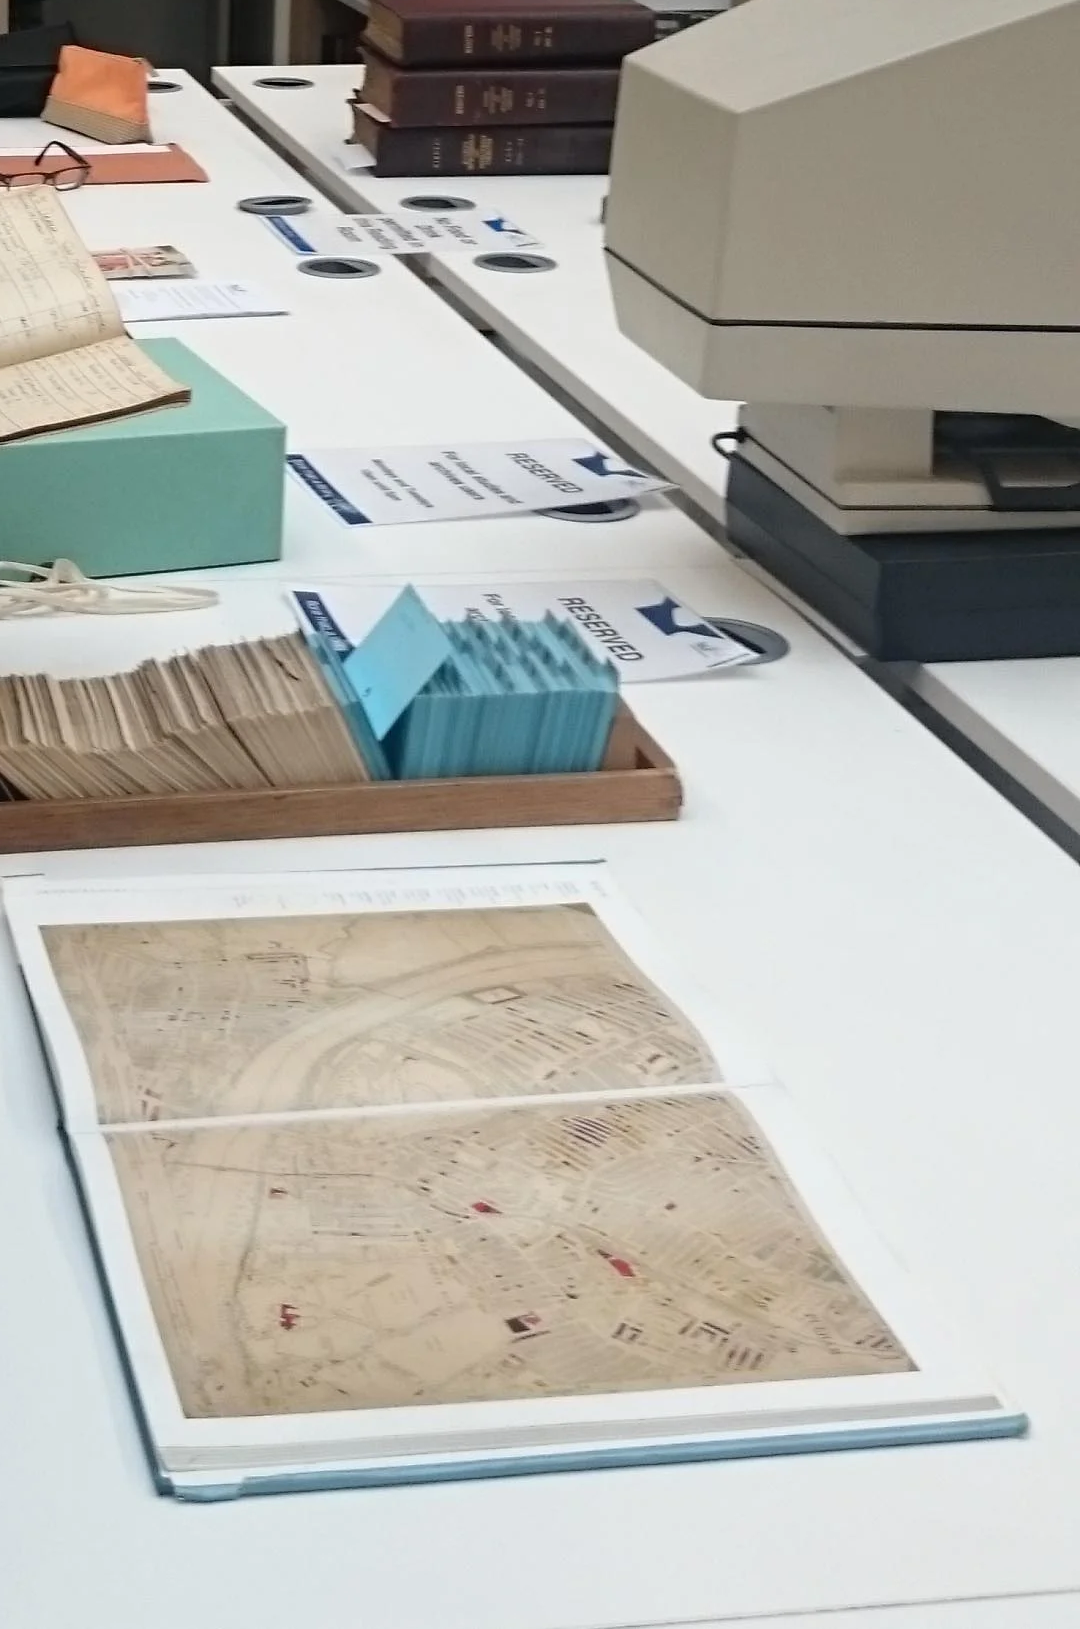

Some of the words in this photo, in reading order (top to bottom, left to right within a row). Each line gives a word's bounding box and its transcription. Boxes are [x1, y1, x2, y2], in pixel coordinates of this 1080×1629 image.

[505, 452, 584, 493] RESERVED
[482, 593, 505, 607] For
[556, 597, 645, 663] RESERVED
